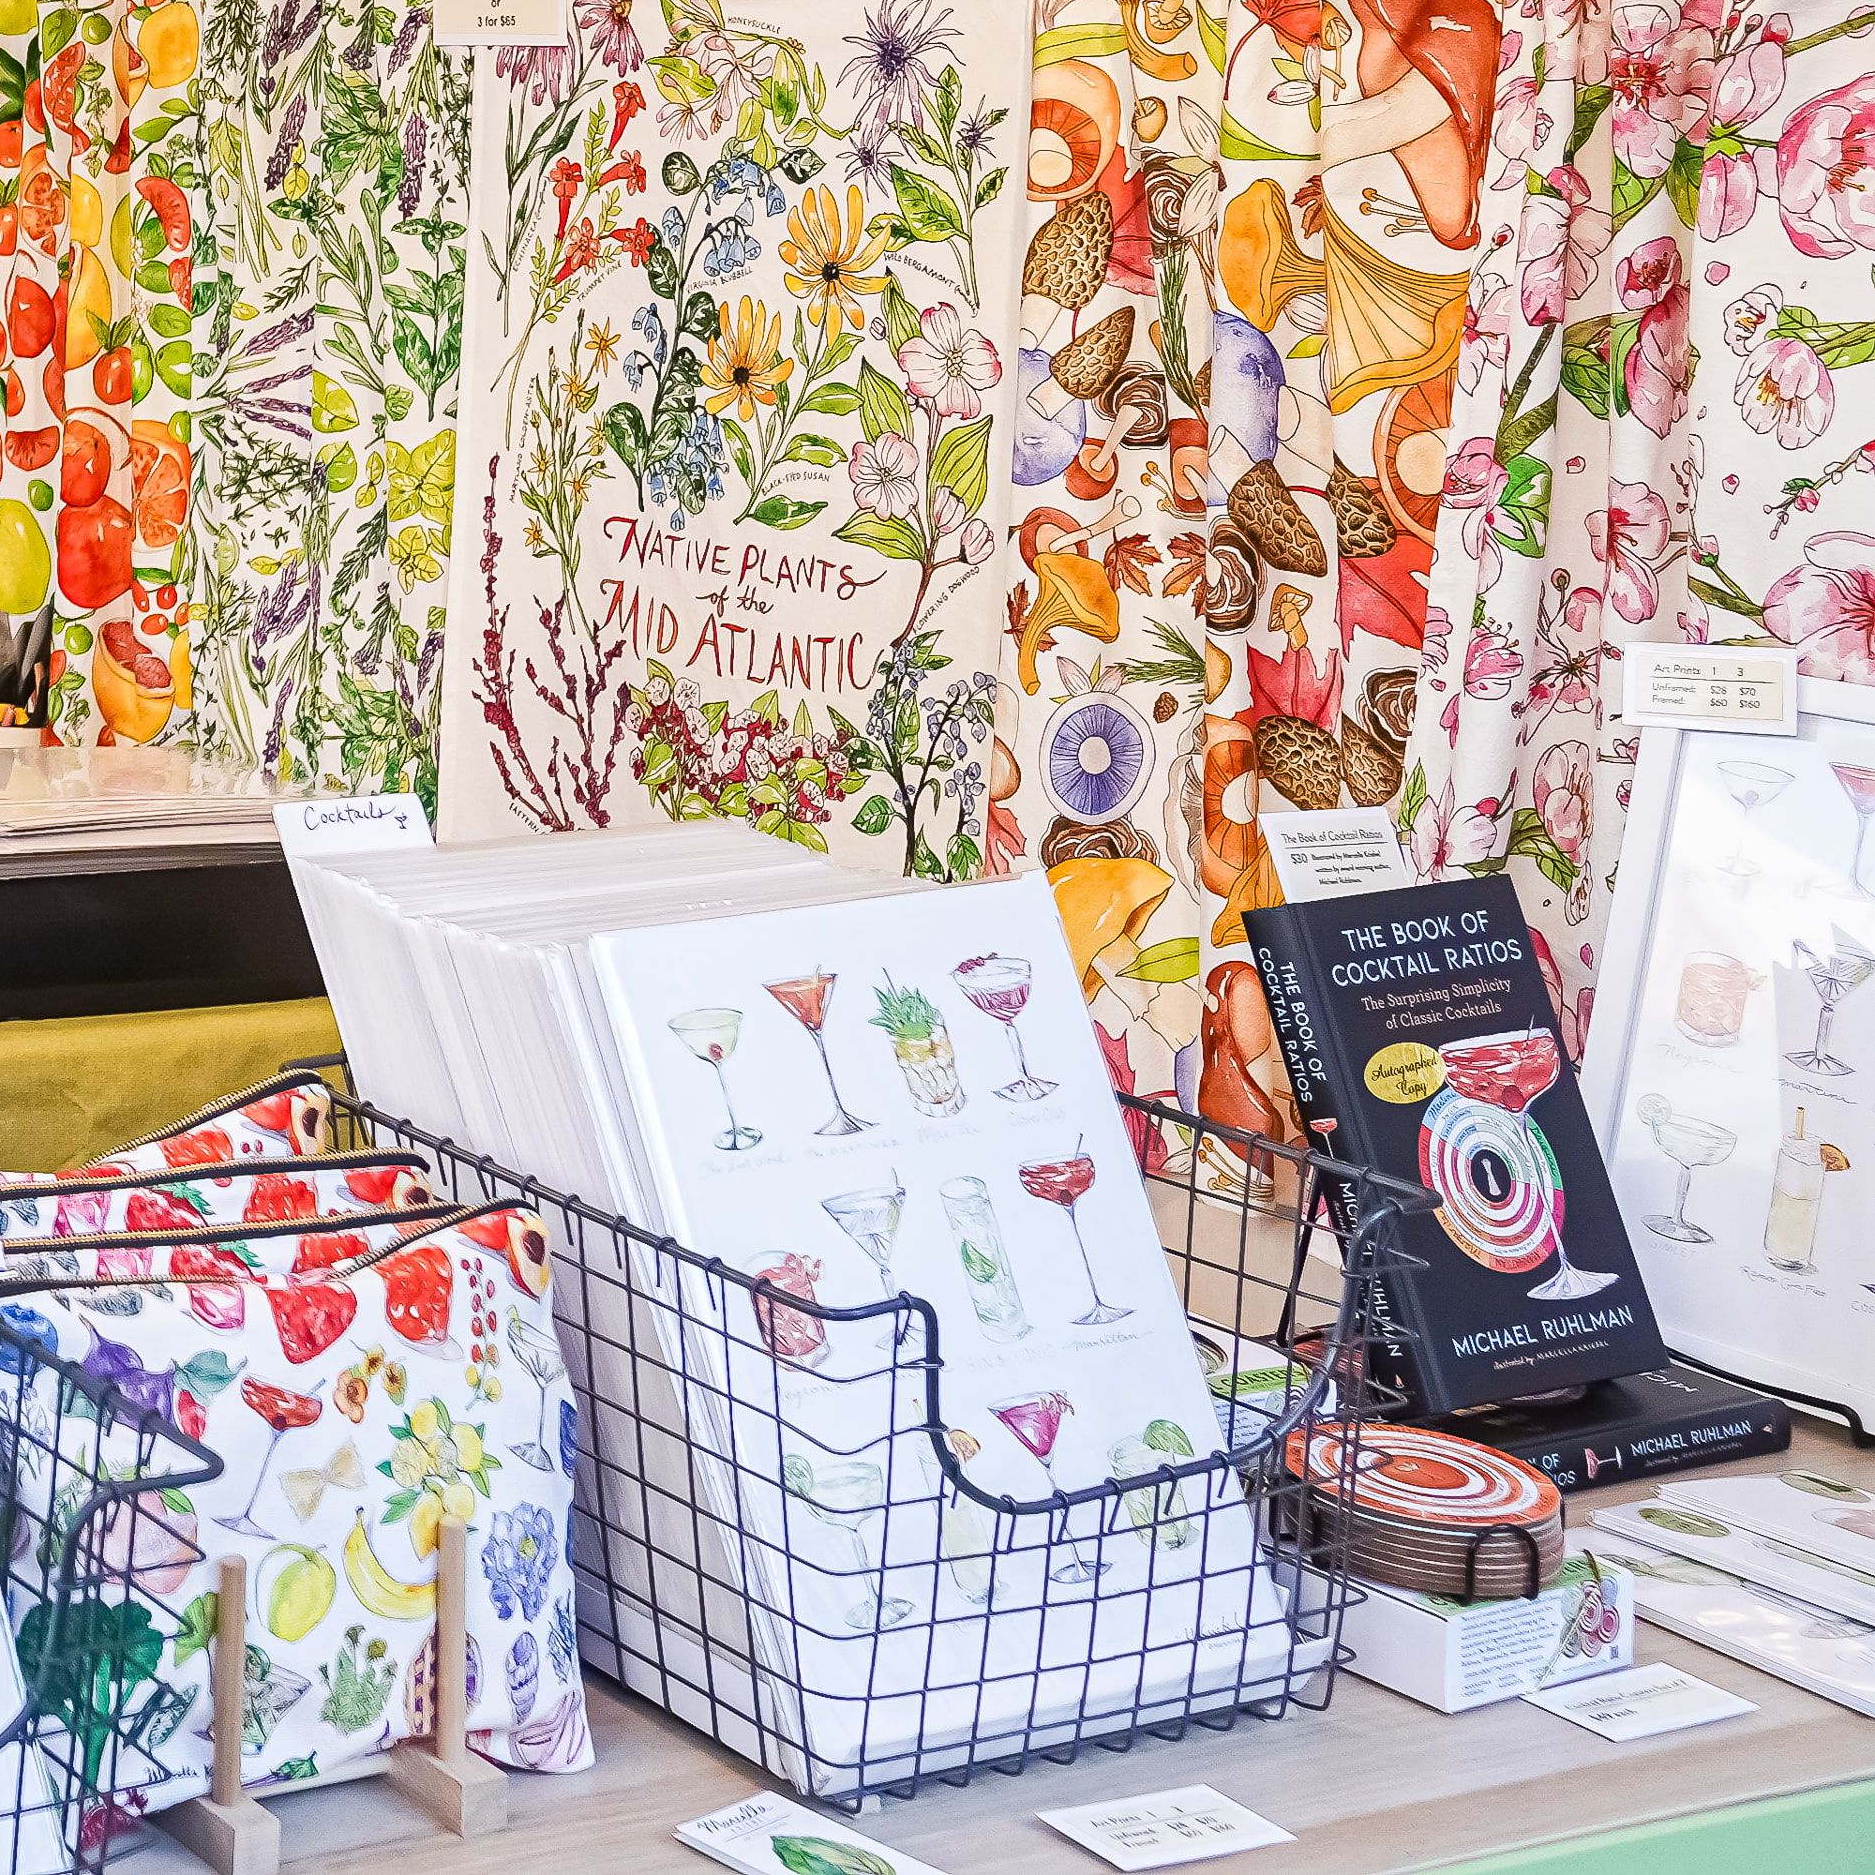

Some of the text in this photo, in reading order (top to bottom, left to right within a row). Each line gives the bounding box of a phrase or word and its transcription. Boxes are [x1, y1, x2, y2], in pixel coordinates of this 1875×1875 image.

[491, 0, 500, 7] or
[478, 17, 482, 27] 3
[485, 16, 497, 26] for
[604, 516, 887, 601] NATIVE PLANTS
[696, 585, 773, 615] of the
[599, 579, 885, 693] MID ATLANTIC
[1654, 664, 1744, 677] Art 3
[1710, 686, 1756, 696] $28 $70
[303, 801, 391, 835] Cocktails
[1342, 910, 1489, 952] THE BOOK OF
[1331, 938, 1523, 987] COCKTAIL RATIOS
[1361, 977, 1511, 1012] The Surprising Simplicity
[1258, 946, 1312, 1103] COCKTAIL RATIOS
[1279, 961, 1326, 1083] THE BOOK OF
[1385, 1000, 1502, 1031] of Classic Cocktails
[1371, 1055, 1438, 1081] Autographed
[1396, 1079, 1428, 1097] Copy
[1452, 1305, 1635, 1359] MICHAEL RUHLMAN
[1630, 1420, 1752, 1457] MICHAEL RUHLMAN
